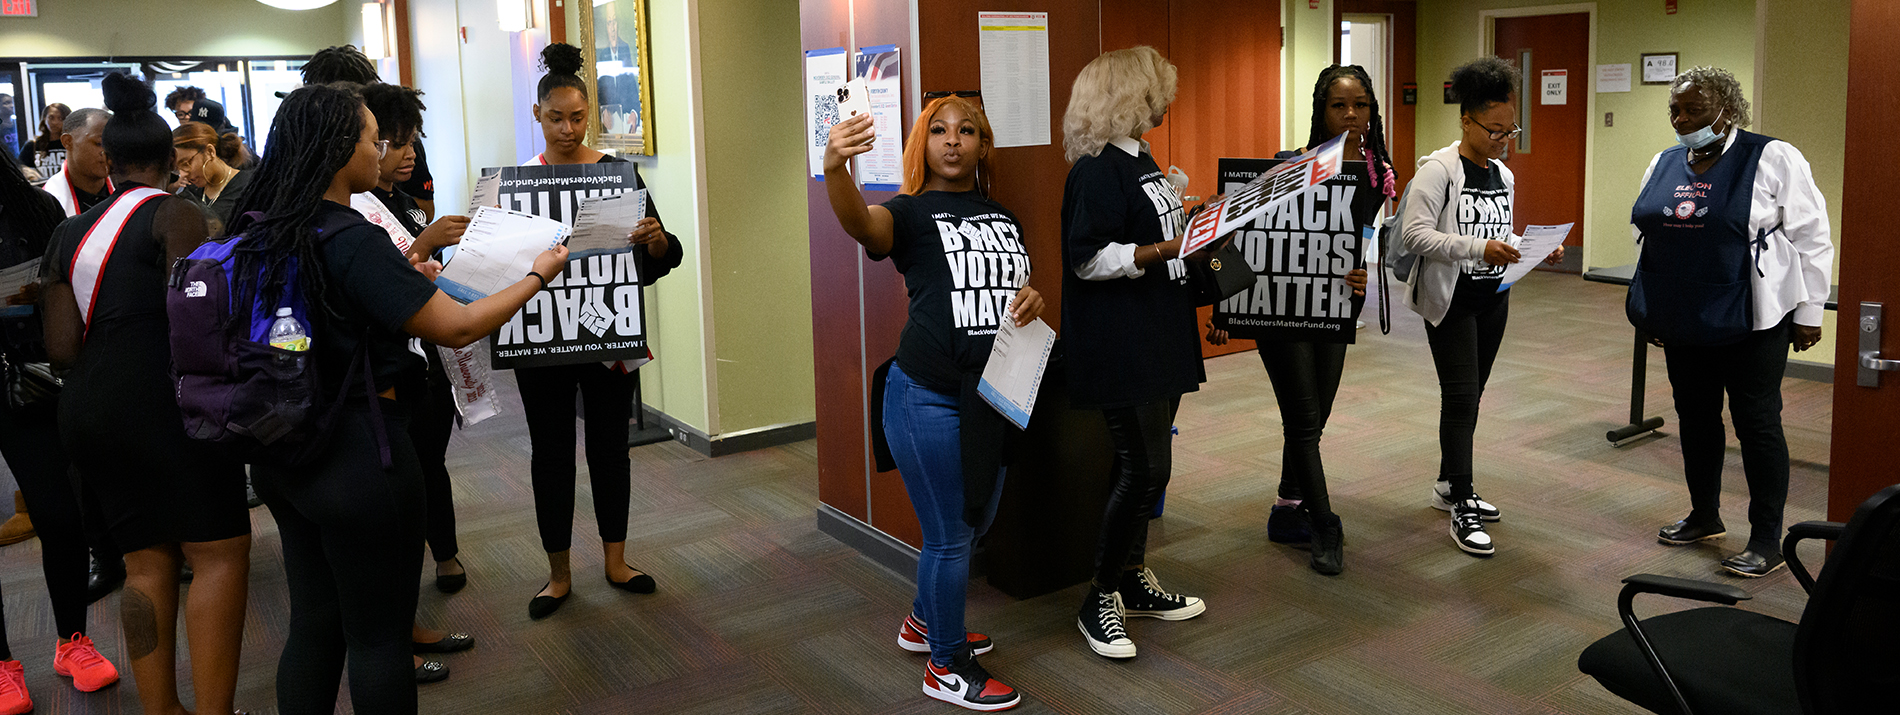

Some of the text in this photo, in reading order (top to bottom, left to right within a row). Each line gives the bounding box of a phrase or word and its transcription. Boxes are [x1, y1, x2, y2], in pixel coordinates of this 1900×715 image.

[1225, 182, 1357, 232] ACK
[1189, 203, 1222, 248] TTER
[1228, 317, 1341, 331] BlackVotersMatterFund.org
[548, 344, 583, 353] MATTER.
[586, 343, 602, 351] YOU
[605, 341, 639, 349] MATTER.
[496, 348, 532, 357] MATTER.
